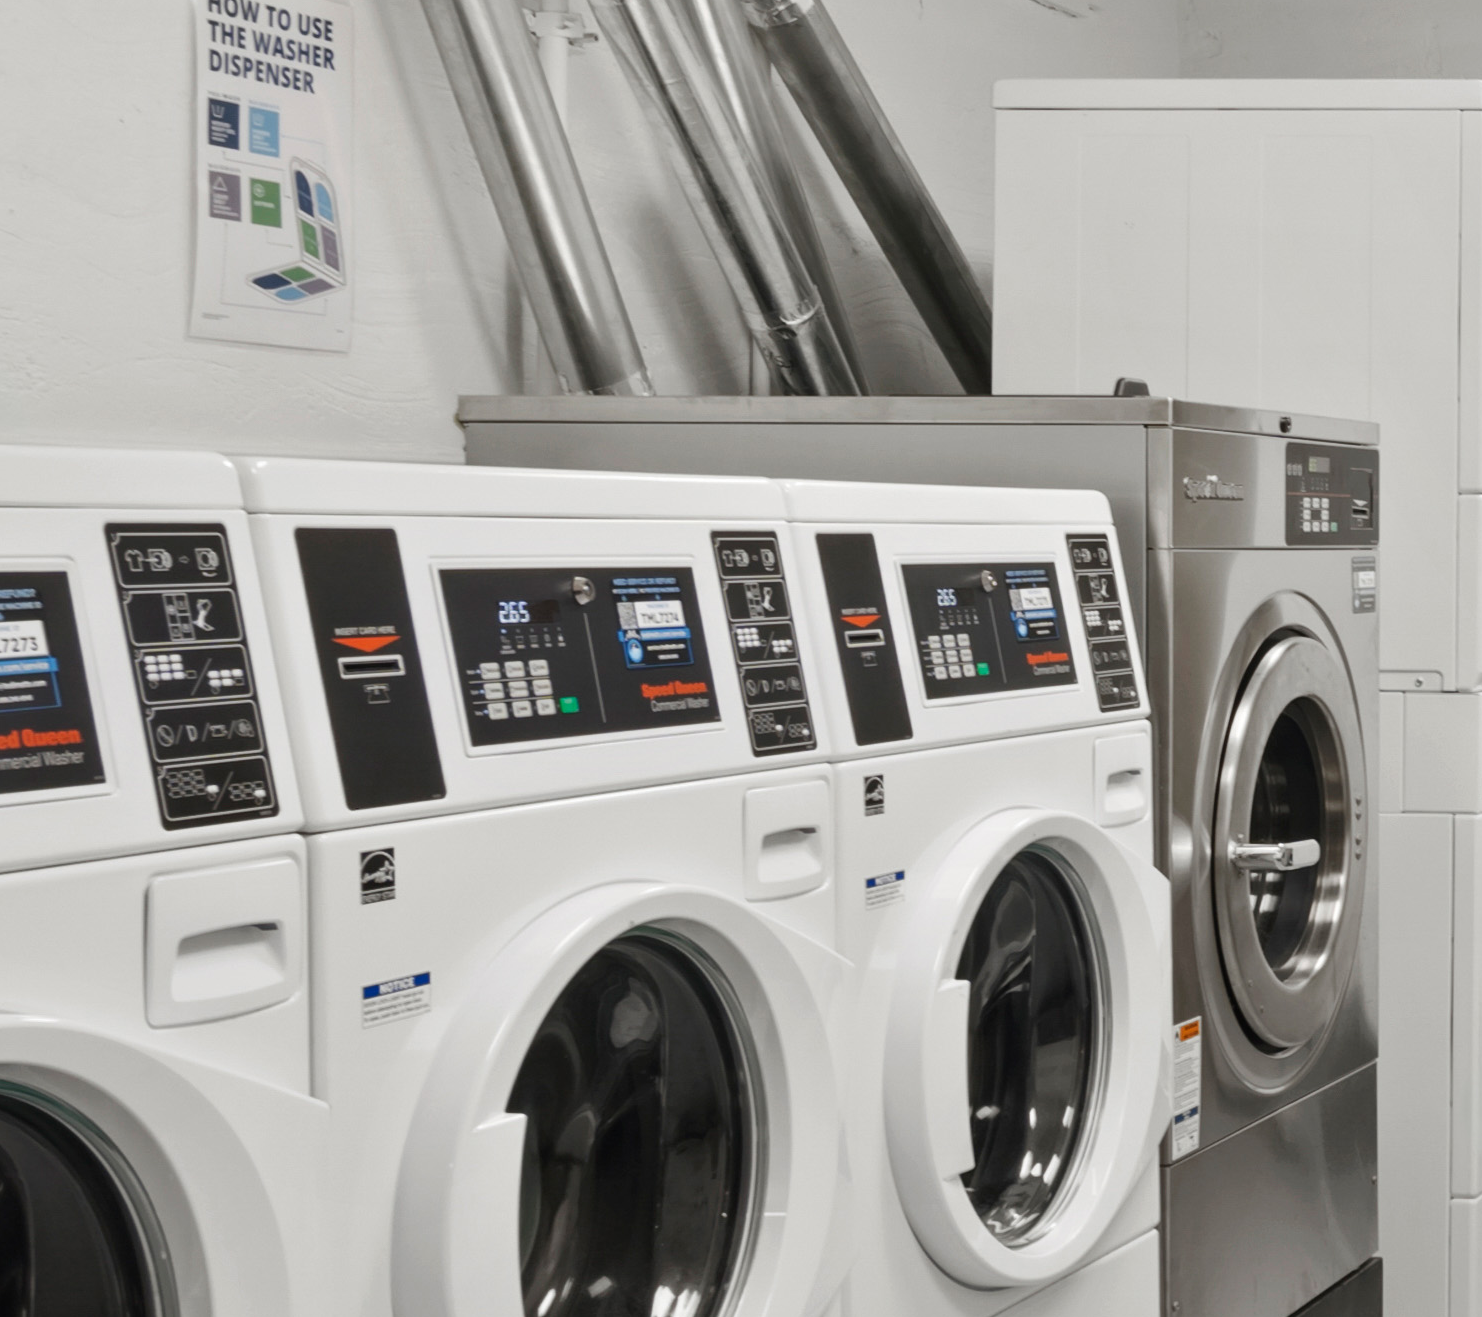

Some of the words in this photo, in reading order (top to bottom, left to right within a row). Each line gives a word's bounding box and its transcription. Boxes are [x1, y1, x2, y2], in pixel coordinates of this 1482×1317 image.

[265, 4, 291, 31] TO
[298, 12, 334, 42] USE
[207, 19, 246, 49] THE
[252, 28, 335, 71] WASHER
[209, 48, 315, 94] DISPENSER
[22, 728, 81, 748] Queen
[42, 751, 85, 767] Washer
[379, 976, 415, 995] NOTICE
